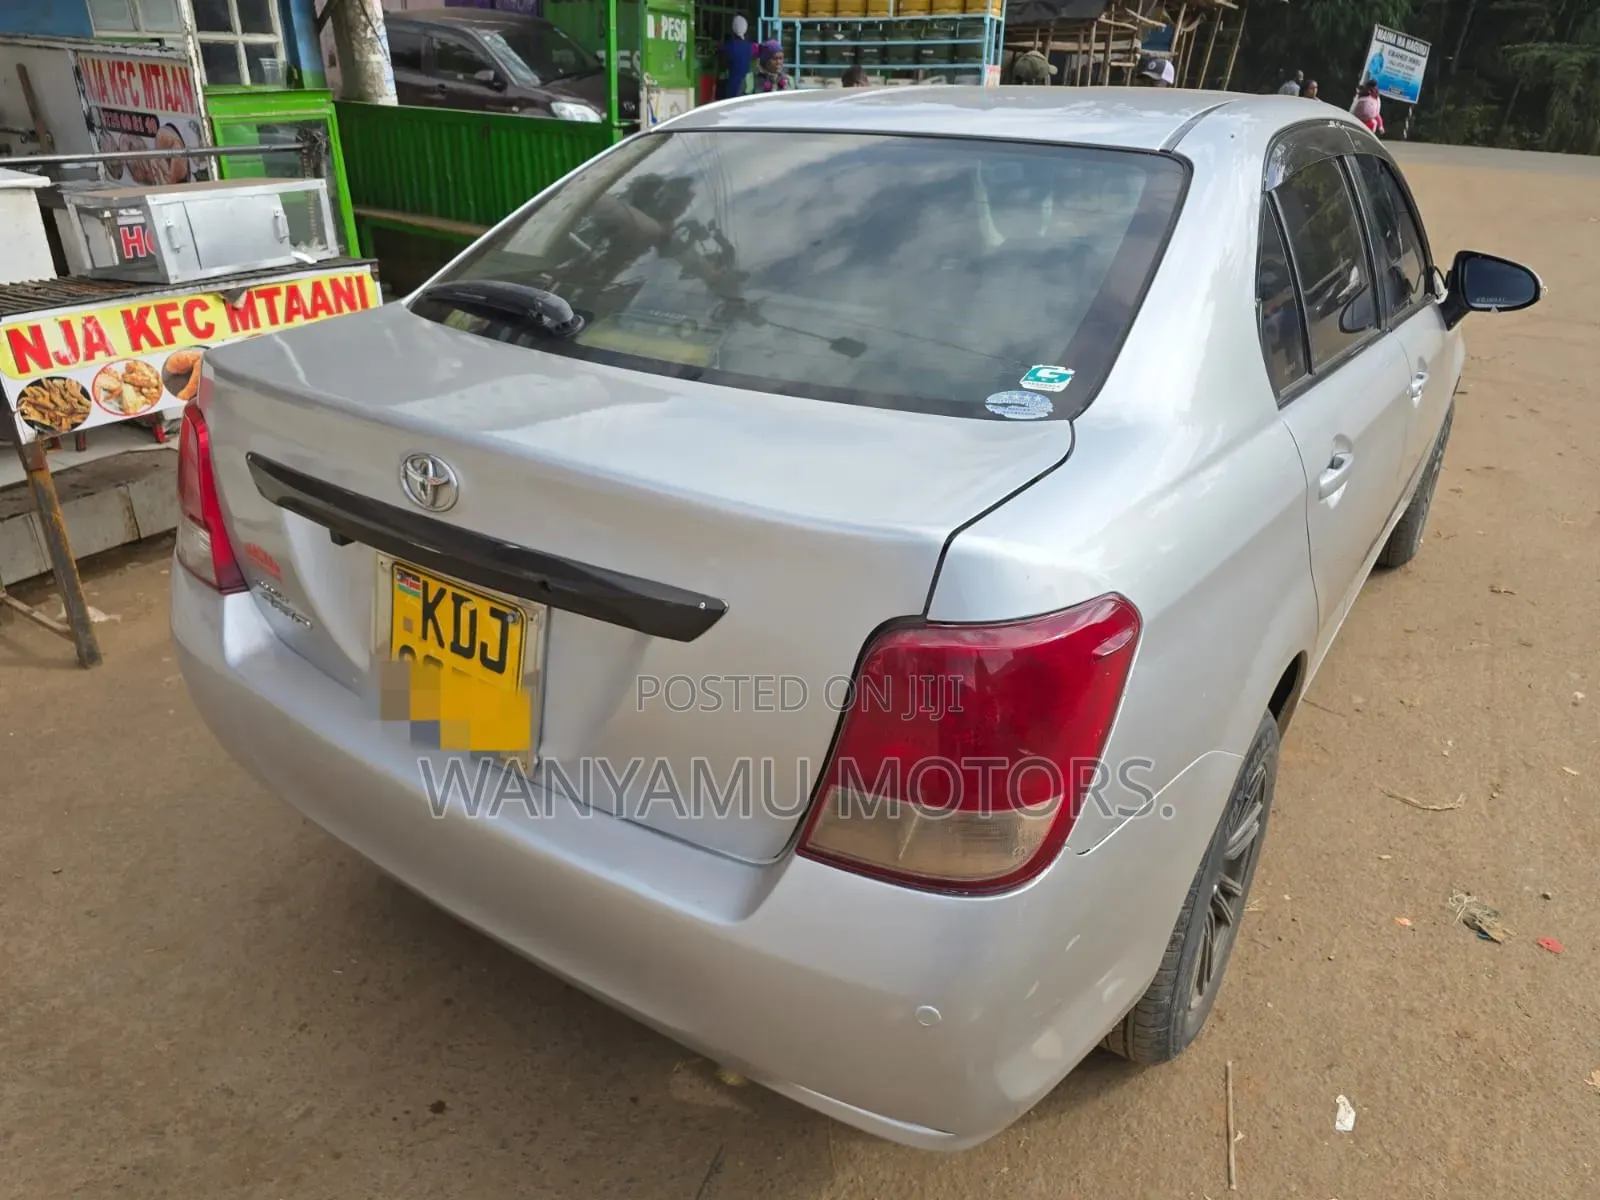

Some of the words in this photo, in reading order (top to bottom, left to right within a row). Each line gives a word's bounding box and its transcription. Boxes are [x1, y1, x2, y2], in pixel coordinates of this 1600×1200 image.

[107, 60, 140, 108] KFC
[6, 315, 116, 375] NJA
[121, 299, 216, 352] KFC
[225, 275, 371, 334] MTAANI
[421, 579, 510, 675] KDJ
